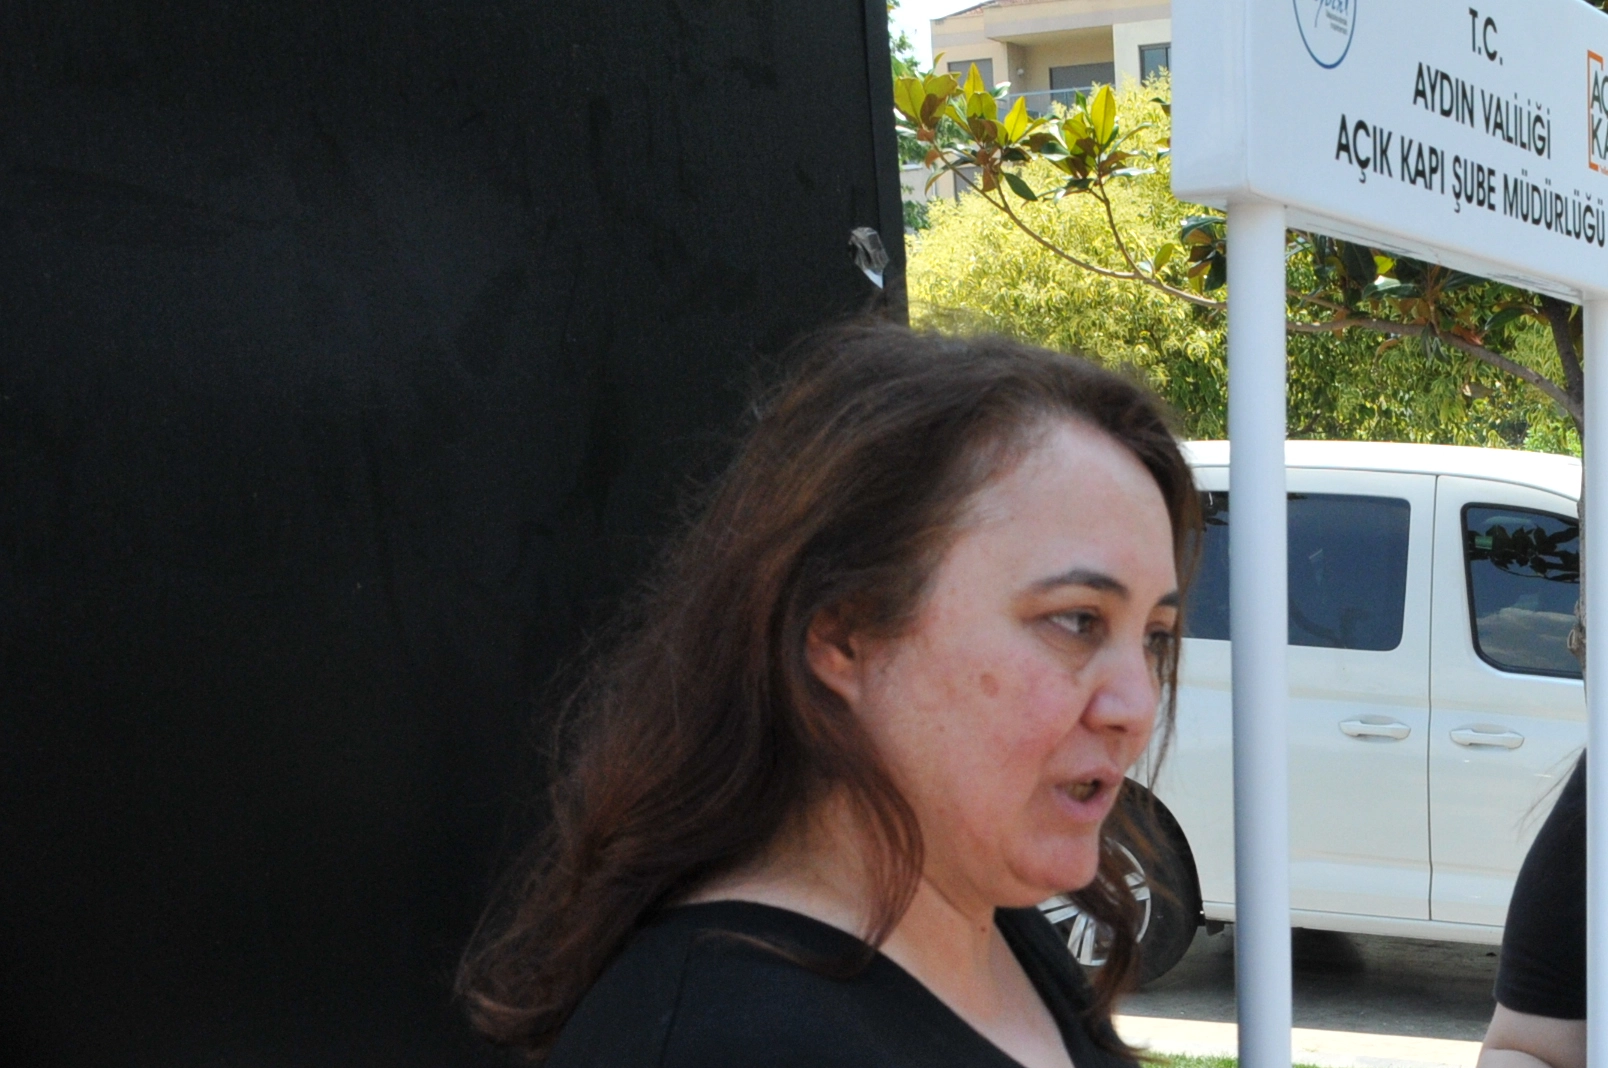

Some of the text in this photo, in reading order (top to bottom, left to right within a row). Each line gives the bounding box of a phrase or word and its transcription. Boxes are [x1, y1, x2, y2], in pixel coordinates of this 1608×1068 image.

[1469, 8, 1503, 65] T.C.
[1413, 62, 1551, 159] AYDIN VALİLİĞİ
[1335, 114, 1605, 248] AÇIK KAPI ŞUBE MÜDÜRLÜĞÜ
